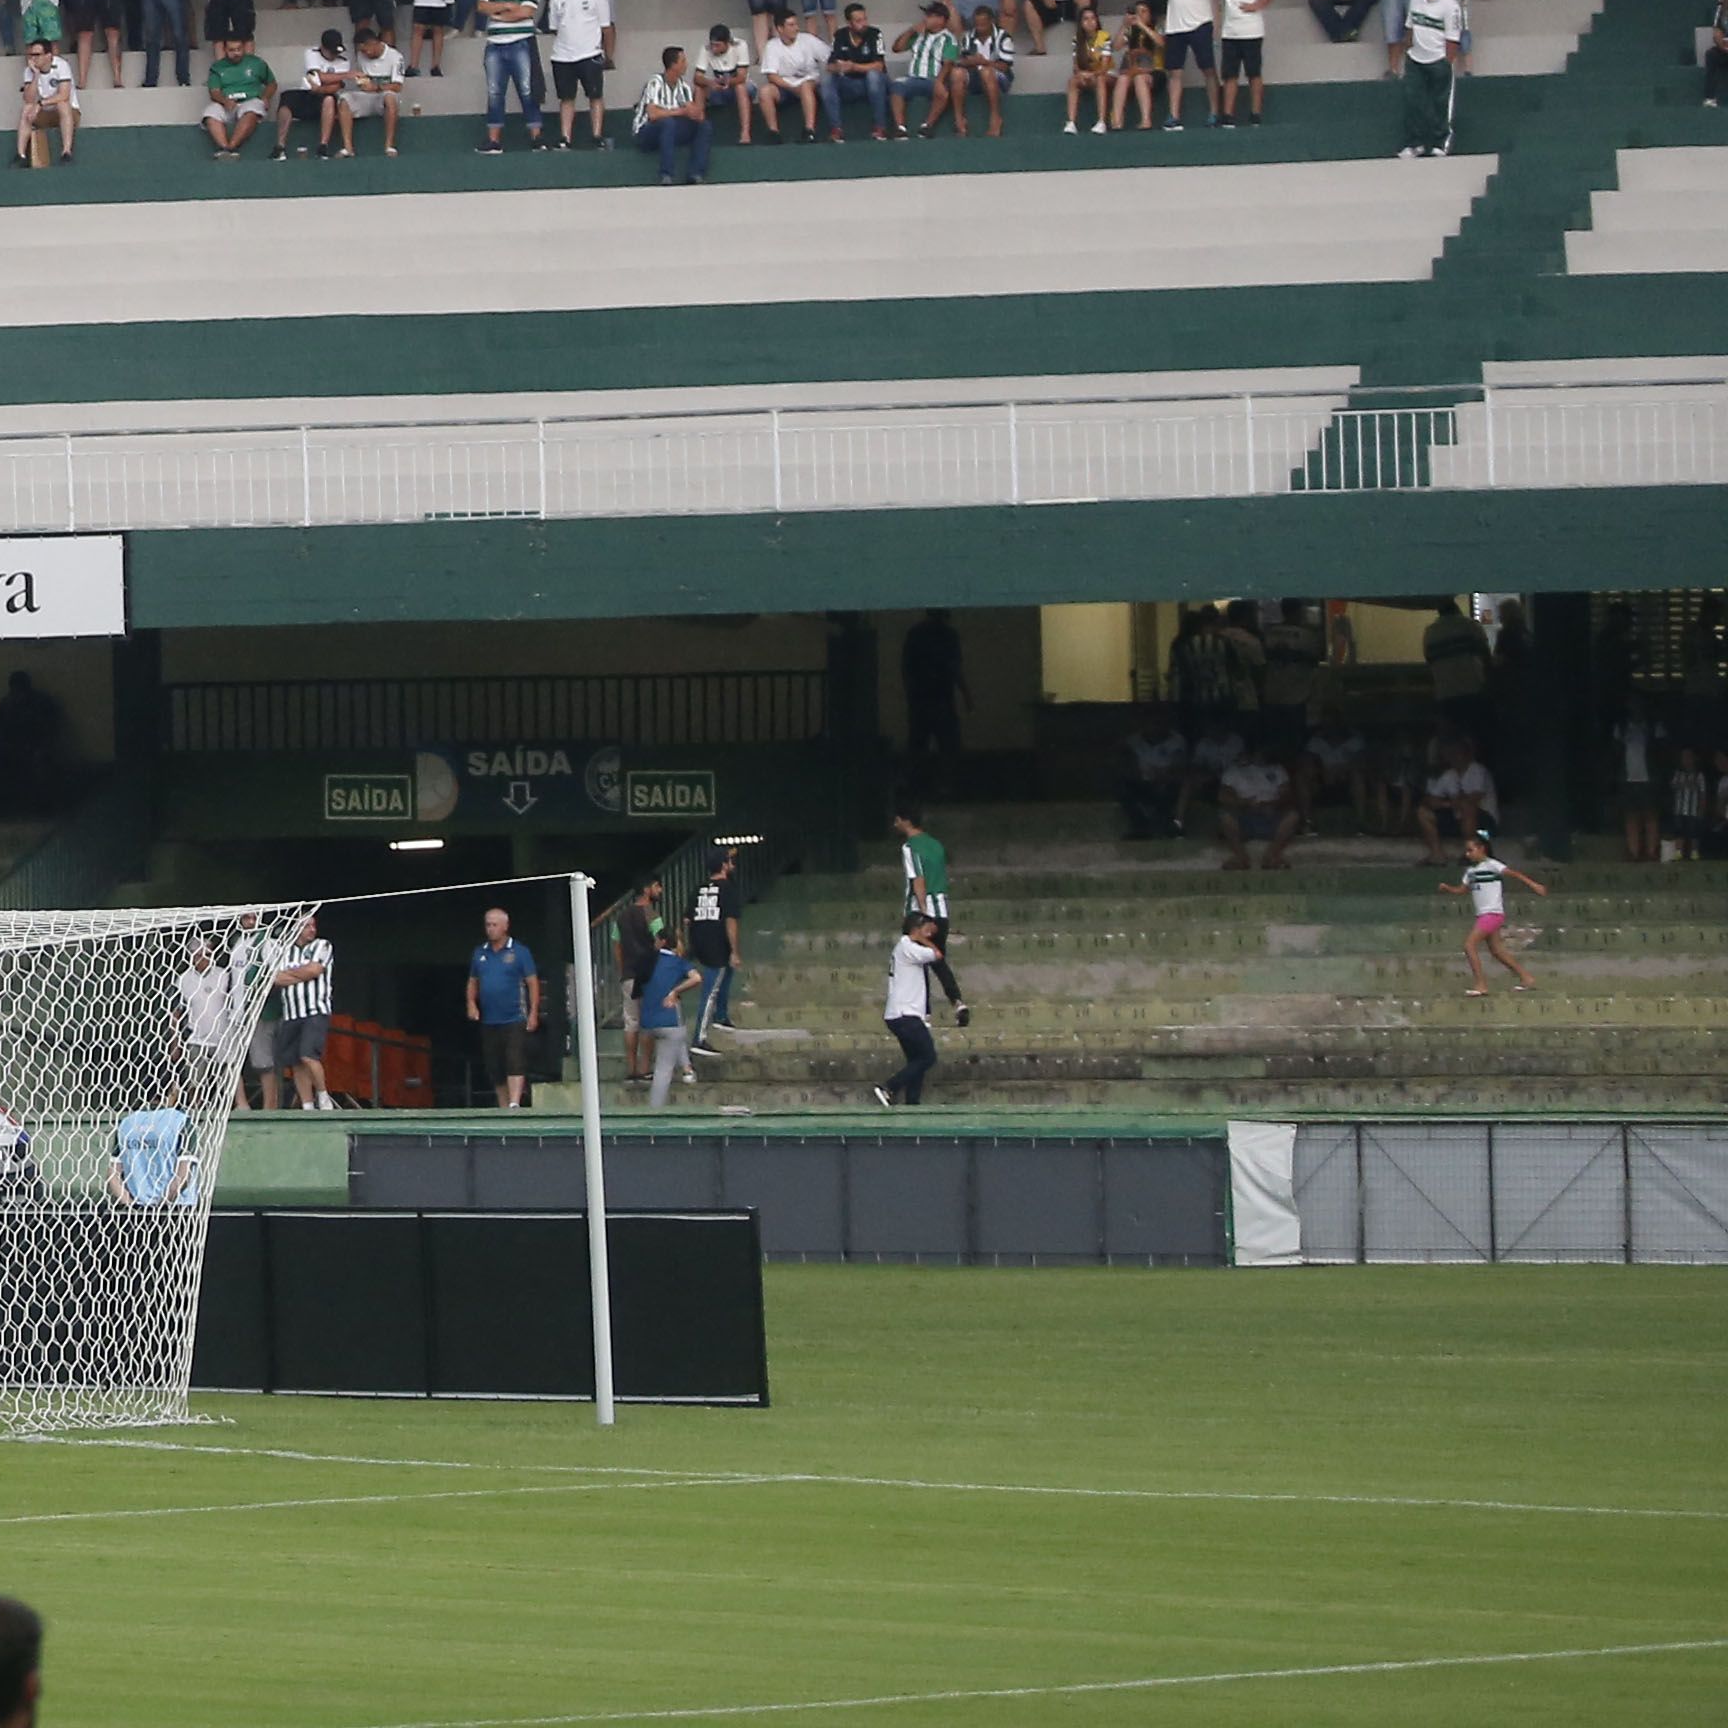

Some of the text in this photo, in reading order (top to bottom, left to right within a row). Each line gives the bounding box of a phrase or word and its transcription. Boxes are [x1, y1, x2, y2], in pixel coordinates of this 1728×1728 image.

[468, 745, 572, 775] SAÍDA
[332, 784, 404, 811] SAÍDA
[633, 781, 707, 808] SAÍDA
